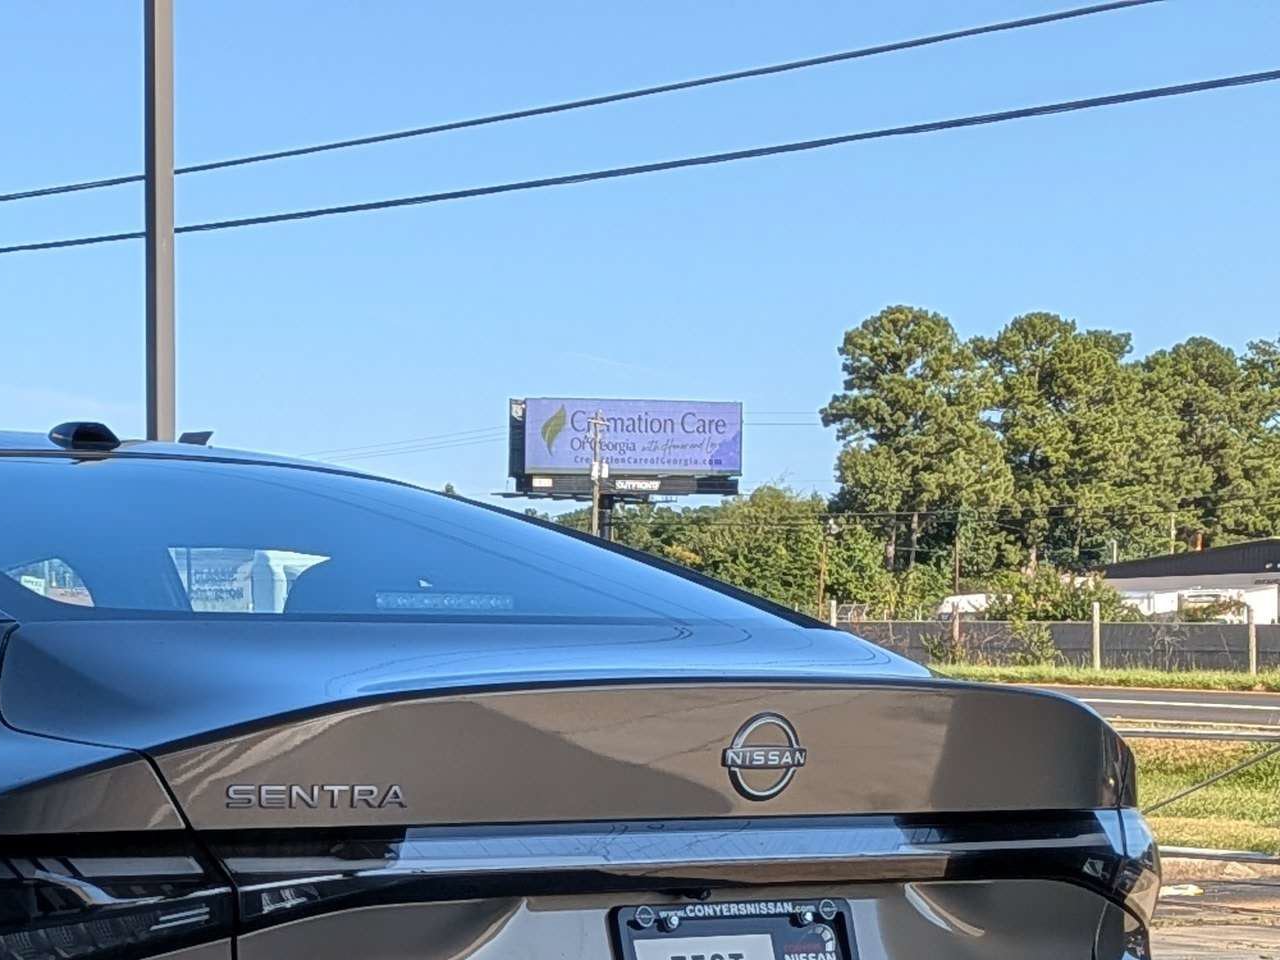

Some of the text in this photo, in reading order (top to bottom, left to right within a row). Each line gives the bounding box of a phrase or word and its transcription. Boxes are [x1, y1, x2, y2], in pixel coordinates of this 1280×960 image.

[680, 412, 727, 434] Care
[574, 455, 723, 467] CretionCareofGeorgia.com
[727, 751, 806, 765] NISSAN
[225, 784, 407, 809] SENTRA
